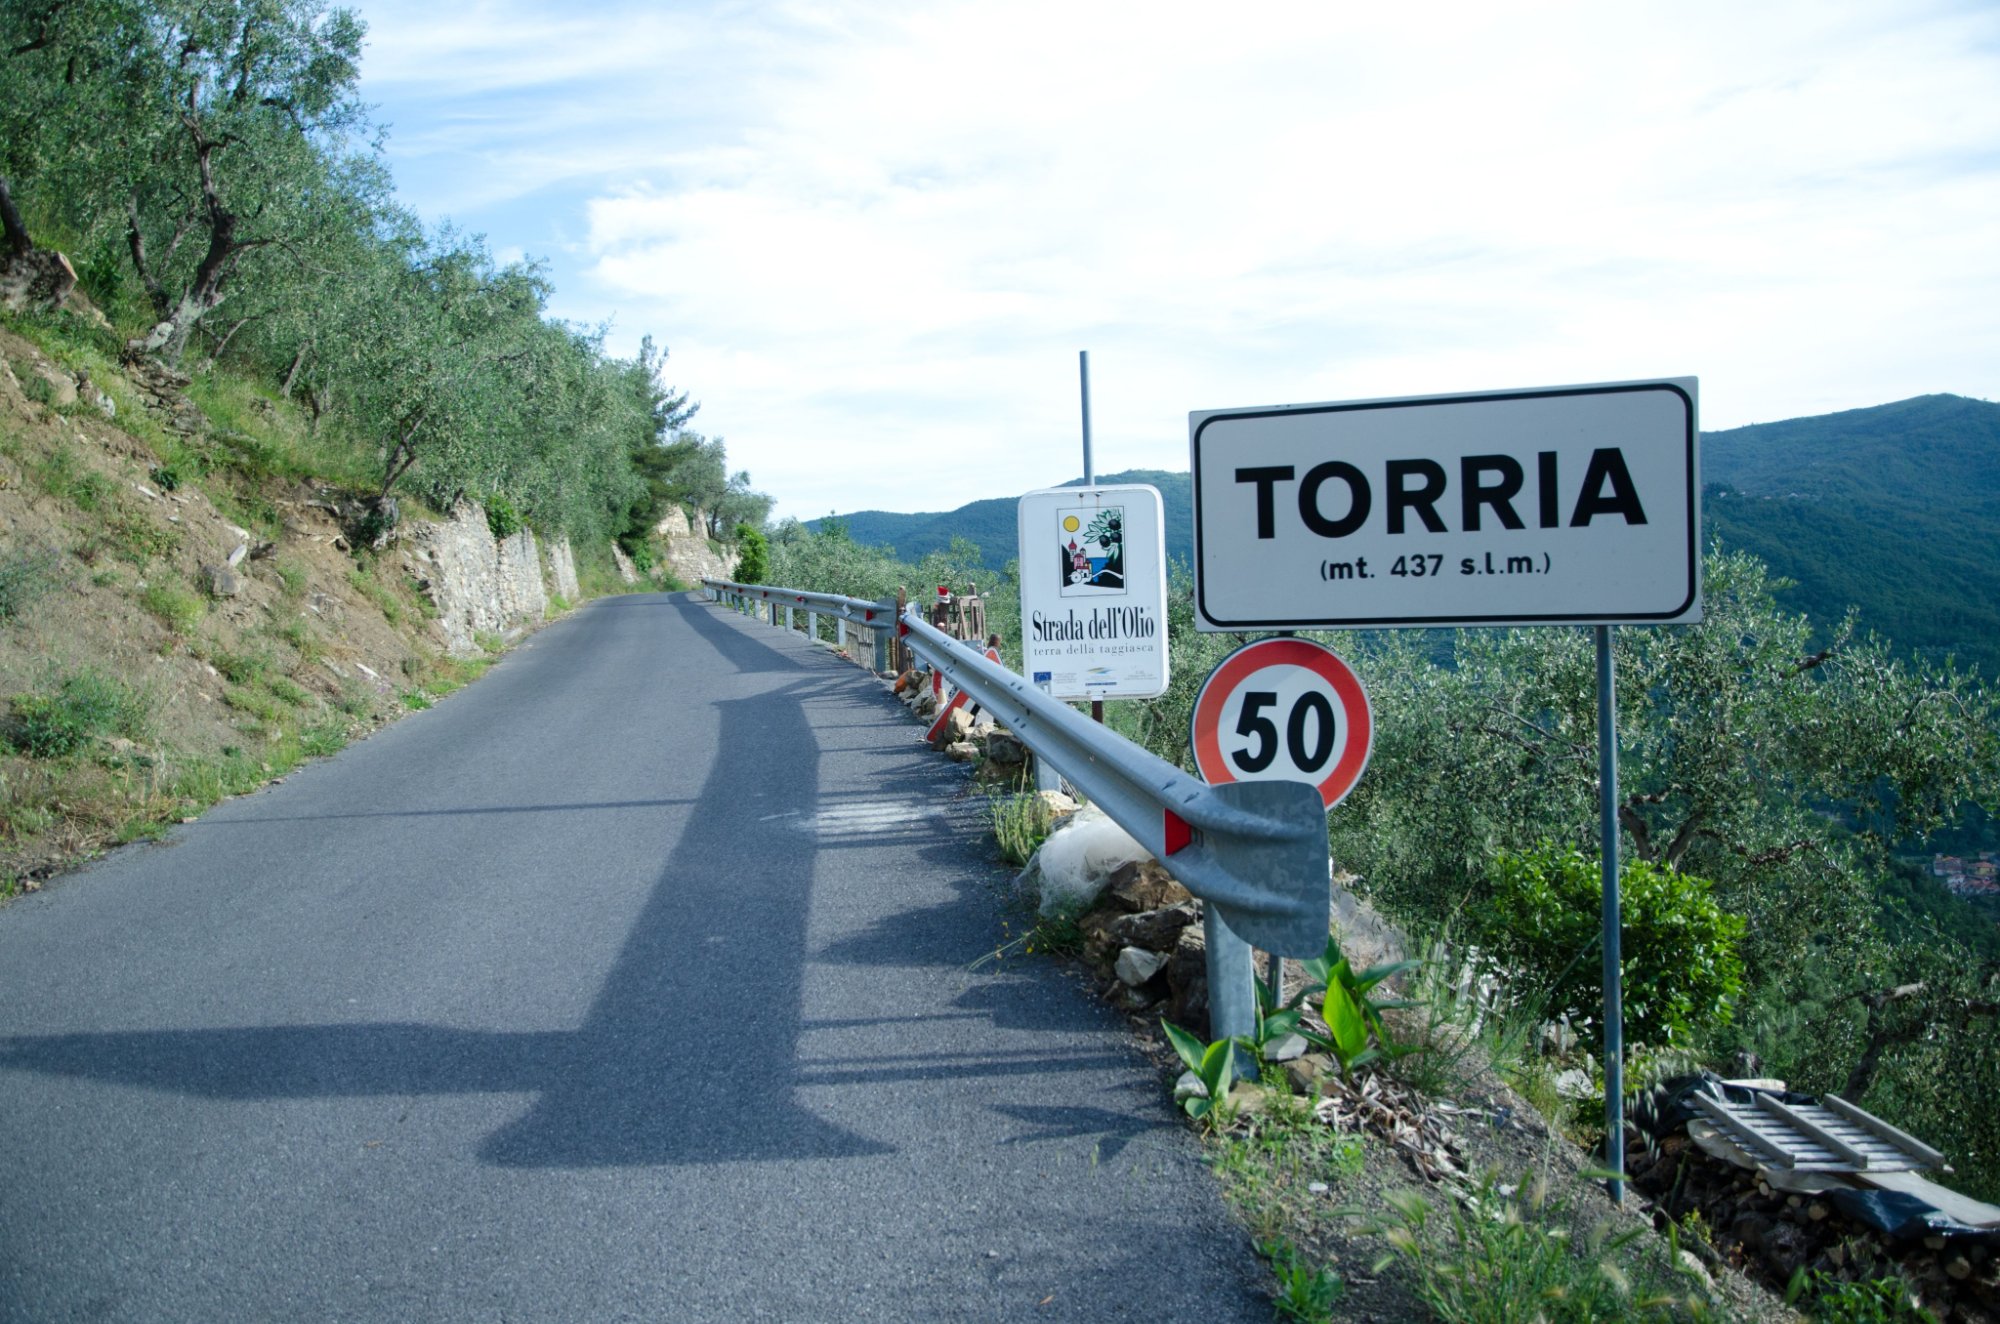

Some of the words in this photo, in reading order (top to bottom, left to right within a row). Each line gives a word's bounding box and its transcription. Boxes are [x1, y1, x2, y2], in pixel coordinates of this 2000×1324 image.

[1235, 447, 1649, 540] TORRIA
[1320, 557, 1375, 582] (mt.
[1390, 554, 1444, 578] 437
[1460, 552, 1551, 576] s.l.m.)
[1032, 609, 1084, 642] Strada
[1088, 606, 1155, 640] dell'Olio
[1034, 647, 1062, 656] terra
[1066, 643, 1095, 655] della
[1099, 642, 1154, 656] taggiasca
[1231, 690, 1336, 773] 50
